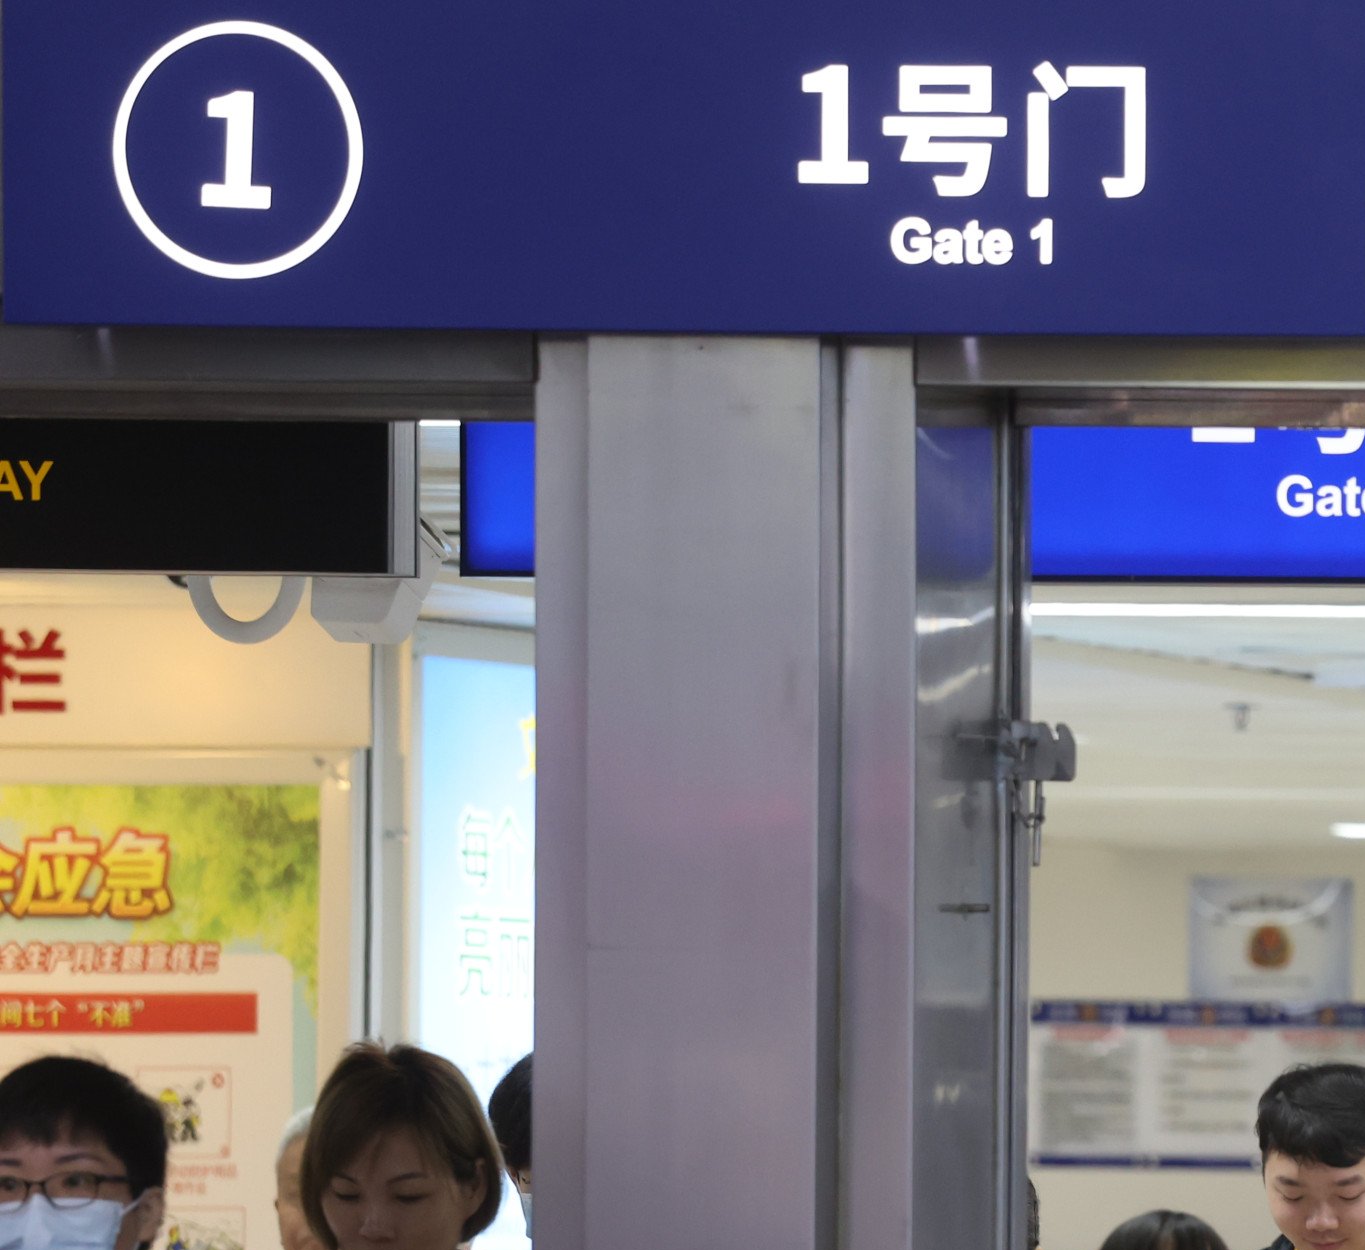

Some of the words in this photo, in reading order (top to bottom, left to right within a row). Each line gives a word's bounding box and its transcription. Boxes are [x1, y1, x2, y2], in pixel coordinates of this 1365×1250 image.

[201, 91, 272, 210] 1
[797, 61, 1147, 199] 1号门
[890, 217, 1014, 266] Gate
[1029, 218, 1054, 265] 1
[0, 826, 173, 919] 应急
